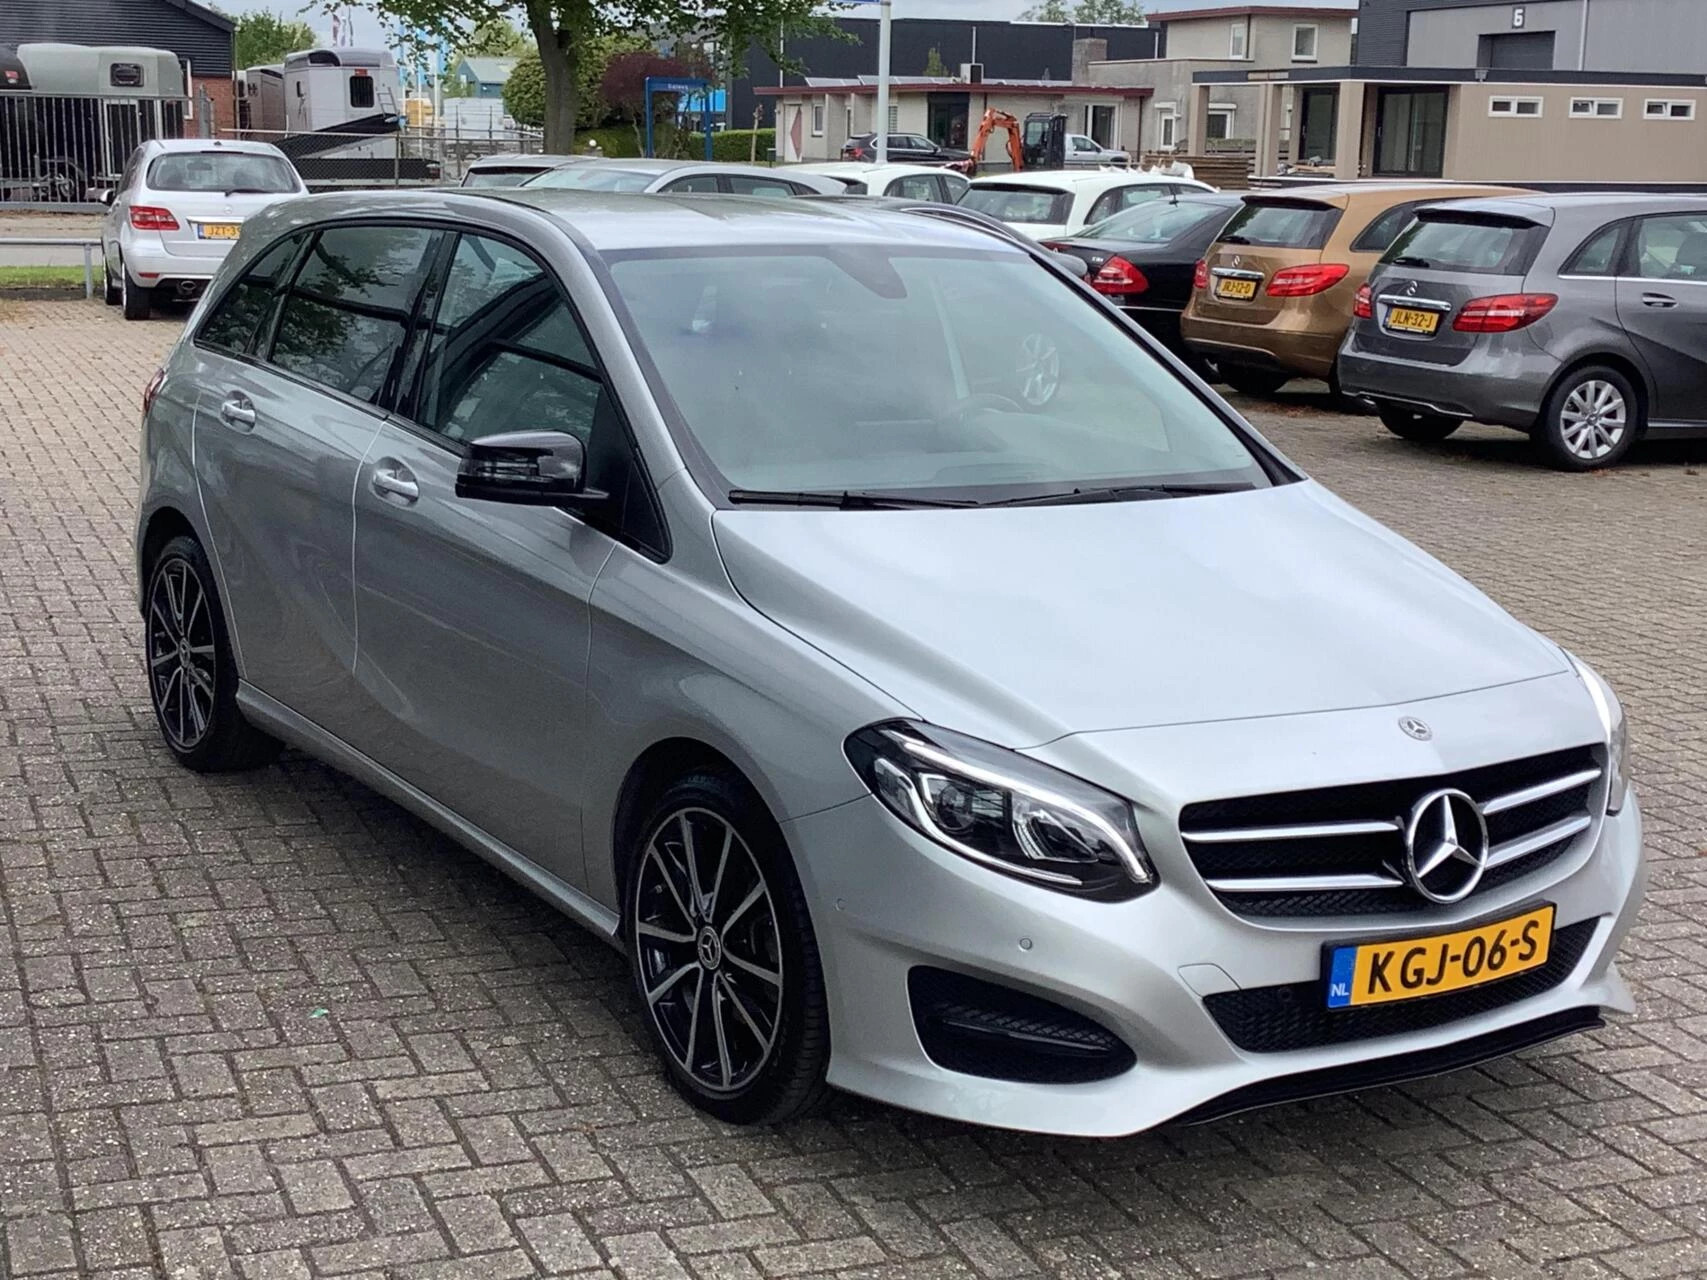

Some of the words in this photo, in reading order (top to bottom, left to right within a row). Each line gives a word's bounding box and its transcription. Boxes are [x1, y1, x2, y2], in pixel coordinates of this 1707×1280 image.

[1514, 8, 1524, 27] 6
[1391, 310, 1434, 329] JLN-32-J
[1367, 919, 1540, 995] KGJ-06-S
[1330, 983, 1349, 997] NL
